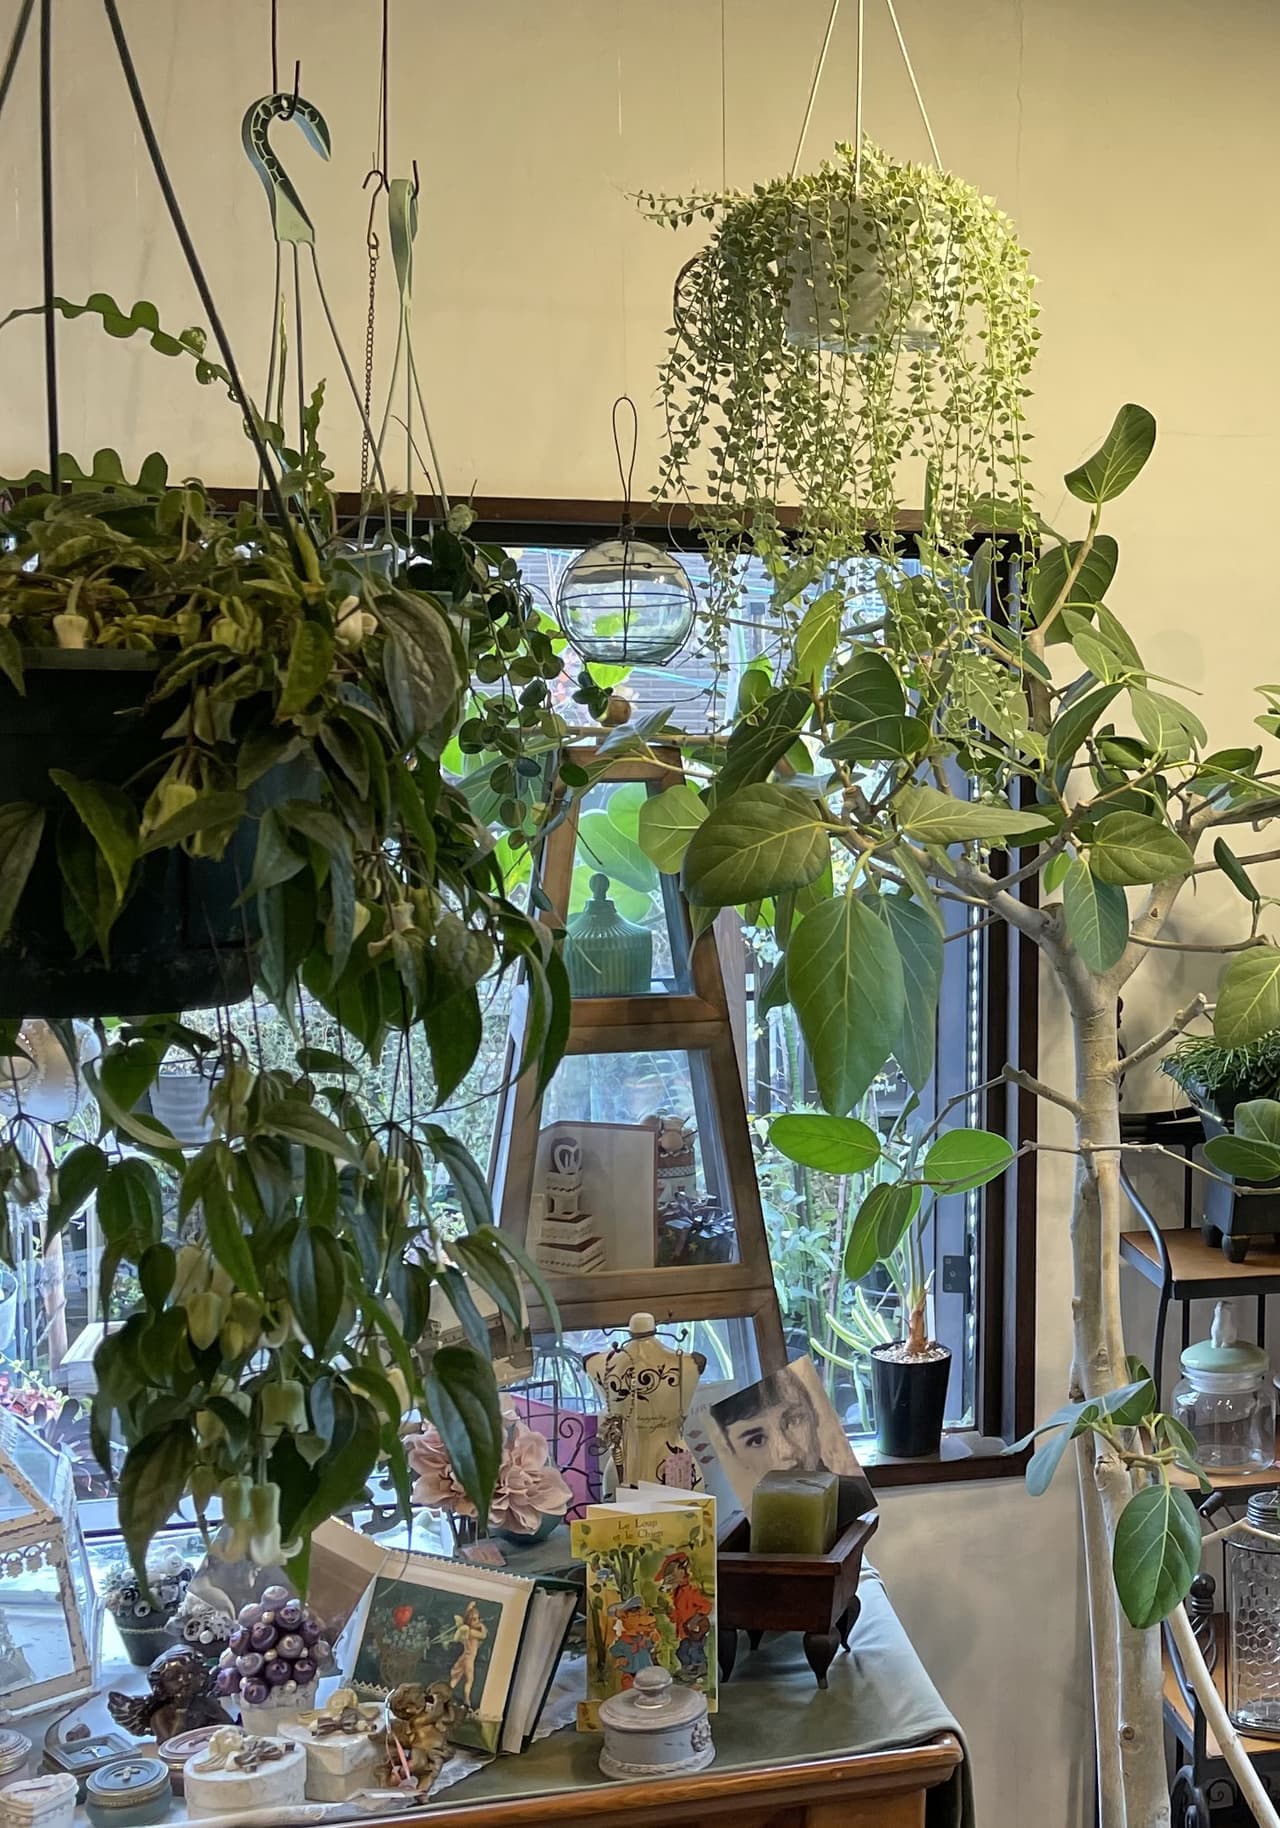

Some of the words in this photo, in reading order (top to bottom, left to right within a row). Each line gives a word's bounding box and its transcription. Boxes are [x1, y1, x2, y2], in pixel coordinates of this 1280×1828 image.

[618, 1520, 630, 1530] Le
[635, 1518, 658, 1529] Loup
[637, 1528, 664, 1538] Chien
